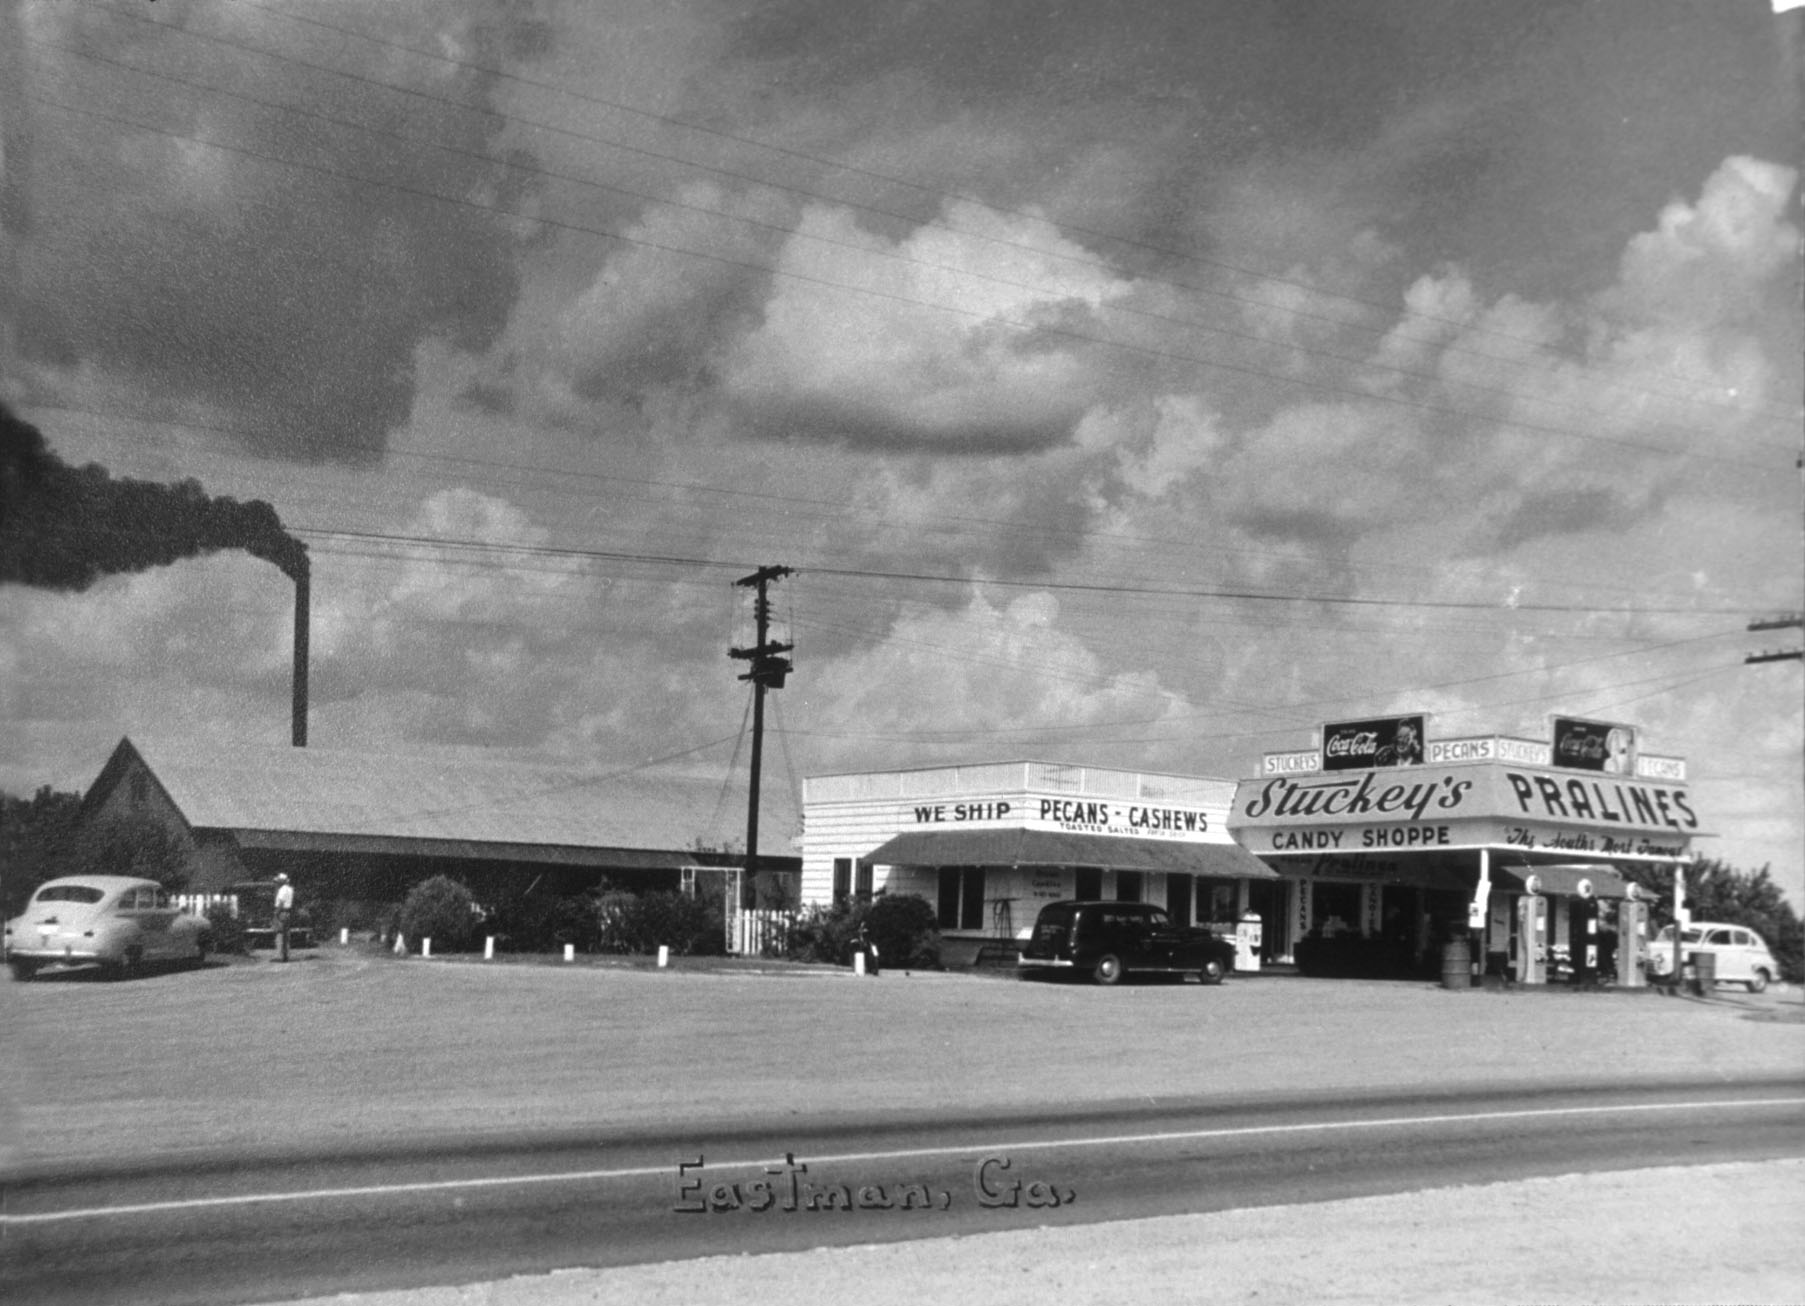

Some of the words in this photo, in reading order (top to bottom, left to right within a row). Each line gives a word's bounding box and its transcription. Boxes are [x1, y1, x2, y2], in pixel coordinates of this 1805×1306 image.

[1432, 741, 1489, 761] PECANS
[1245, 772, 1473, 819] Stuckey's
[1507, 773, 1698, 827] PRALINES
[915, 806, 946, 823] WE
[954, 802, 1011, 821] SHIP
[1041, 799, 1109, 826] PECANS
[1129, 806, 1208, 833] CASHEWS
[1060, 822, 1103, 833] TOASTED
[1107, 825, 1140, 835] SALTED
[1272, 831, 1344, 849] CANDY
[1362, 826, 1450, 847] SHOPPE
